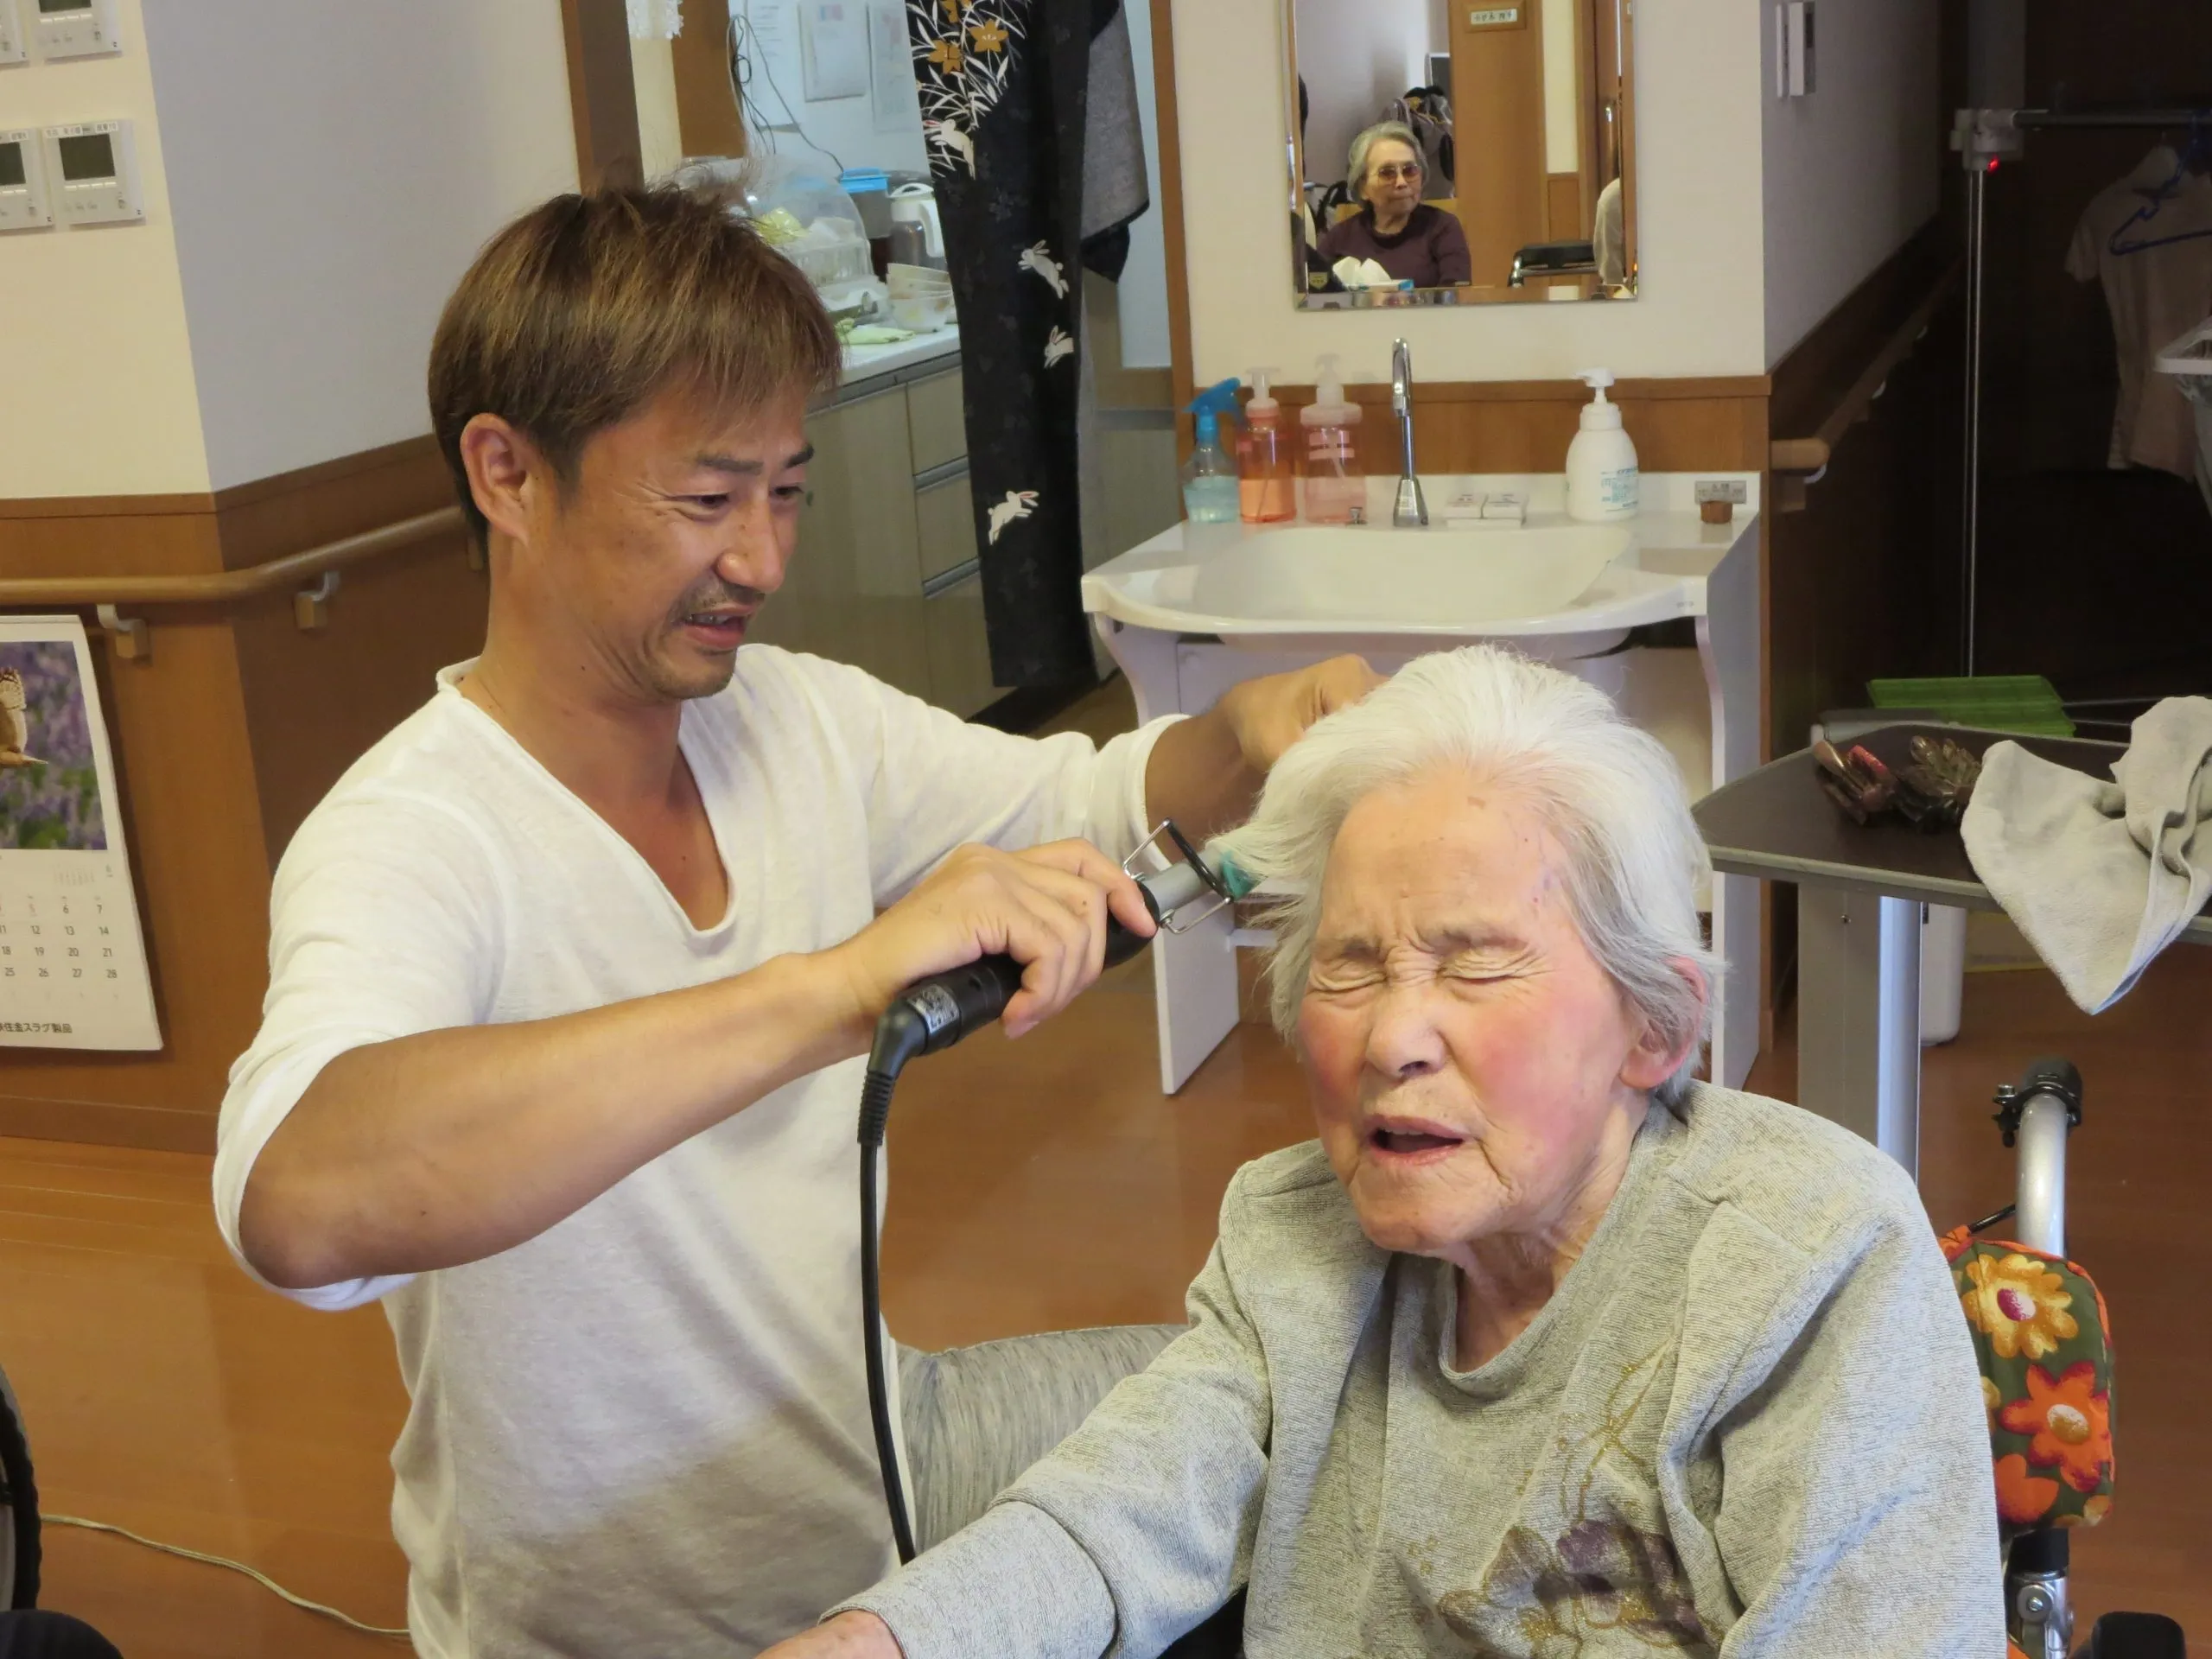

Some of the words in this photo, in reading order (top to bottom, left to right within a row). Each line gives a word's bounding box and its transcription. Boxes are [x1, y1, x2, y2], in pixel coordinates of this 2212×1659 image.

[62, 904, 69, 914] 6
[96, 904, 103, 914] 7
[30, 925, 41, 935] 12
[65, 925, 75, 936] 13
[99, 926, 110, 935] 14
[2, 945, 11, 956] 18
[35, 946, 45, 957] 19
[68, 947, 79, 957] 20
[102, 947, 112, 957] 21
[4, 967, 16, 976] 25
[38, 967, 49, 977] 26
[72, 968, 82, 978] 27
[106, 969, 118, 979] 28
